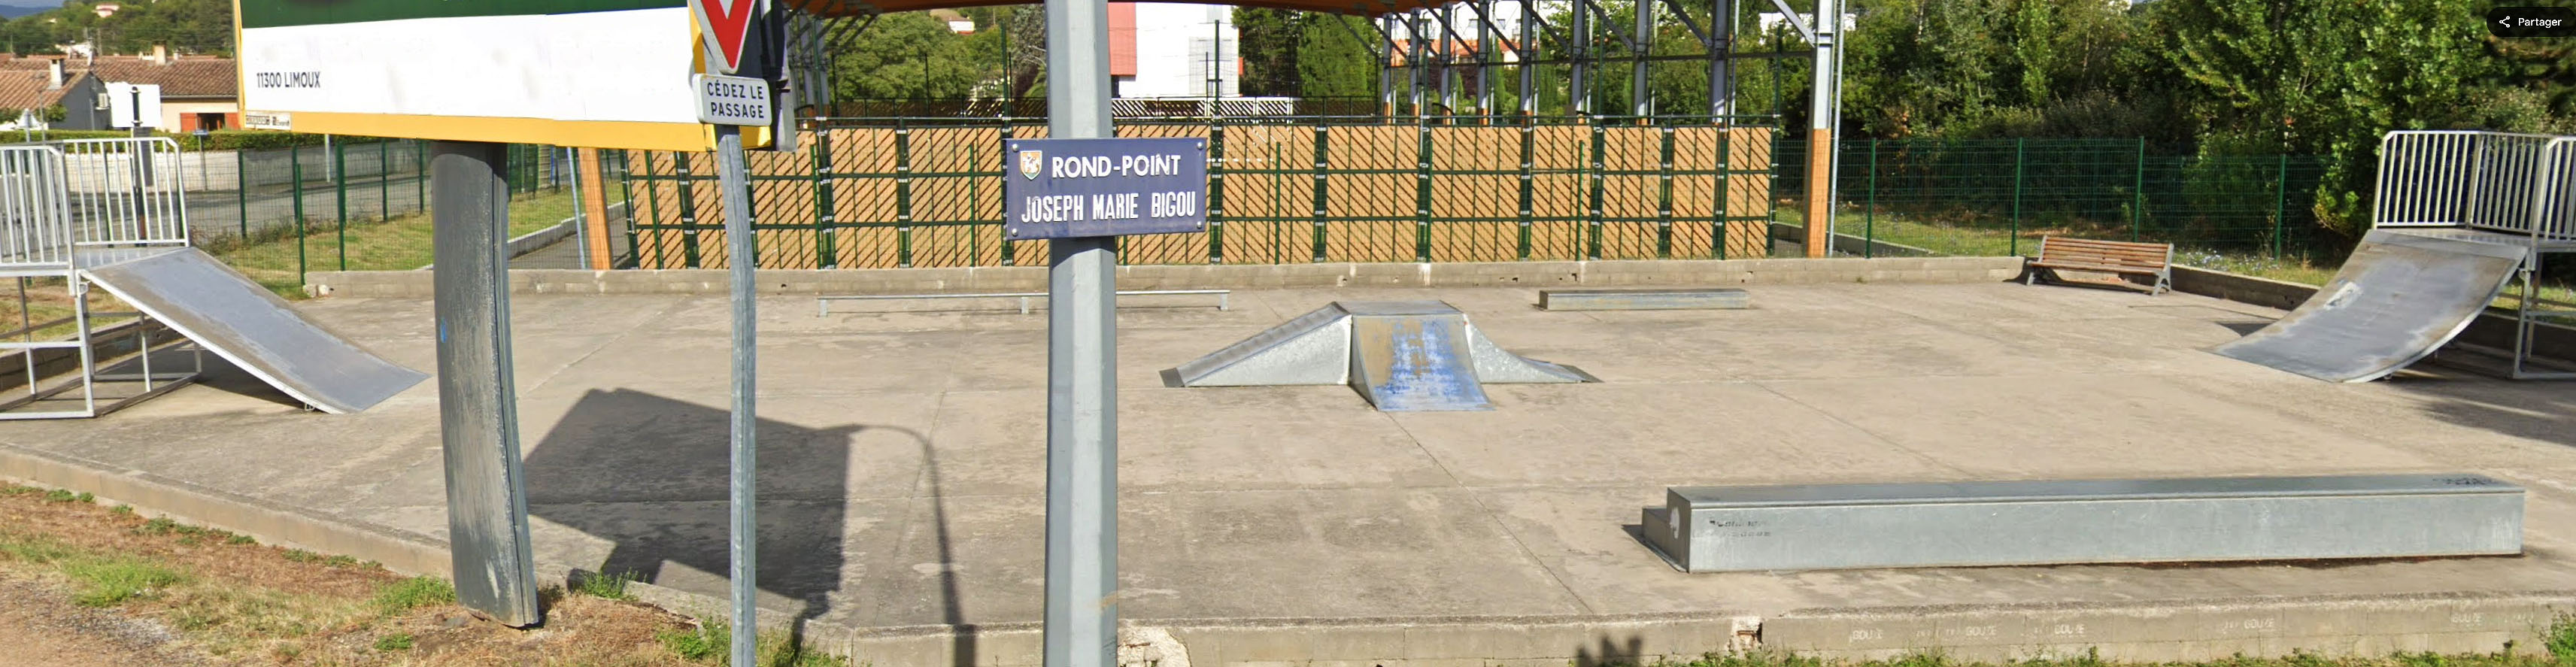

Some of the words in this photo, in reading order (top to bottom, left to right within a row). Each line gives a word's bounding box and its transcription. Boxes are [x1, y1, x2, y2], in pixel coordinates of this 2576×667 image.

[256, 72, 282, 88] 11300
[284, 71, 320, 87] LIMOUX
[707, 80, 746, 99] CÉDEZ
[750, 86, 764, 99] LE
[711, 102, 765, 118] PASSAGE
[1052, 154, 1181, 178] ROND-POINT
[1021, 195, 1083, 223] JOSEPH
[1093, 193, 1139, 220] MARIE
[1151, 191, 1196, 218] BIGOU
